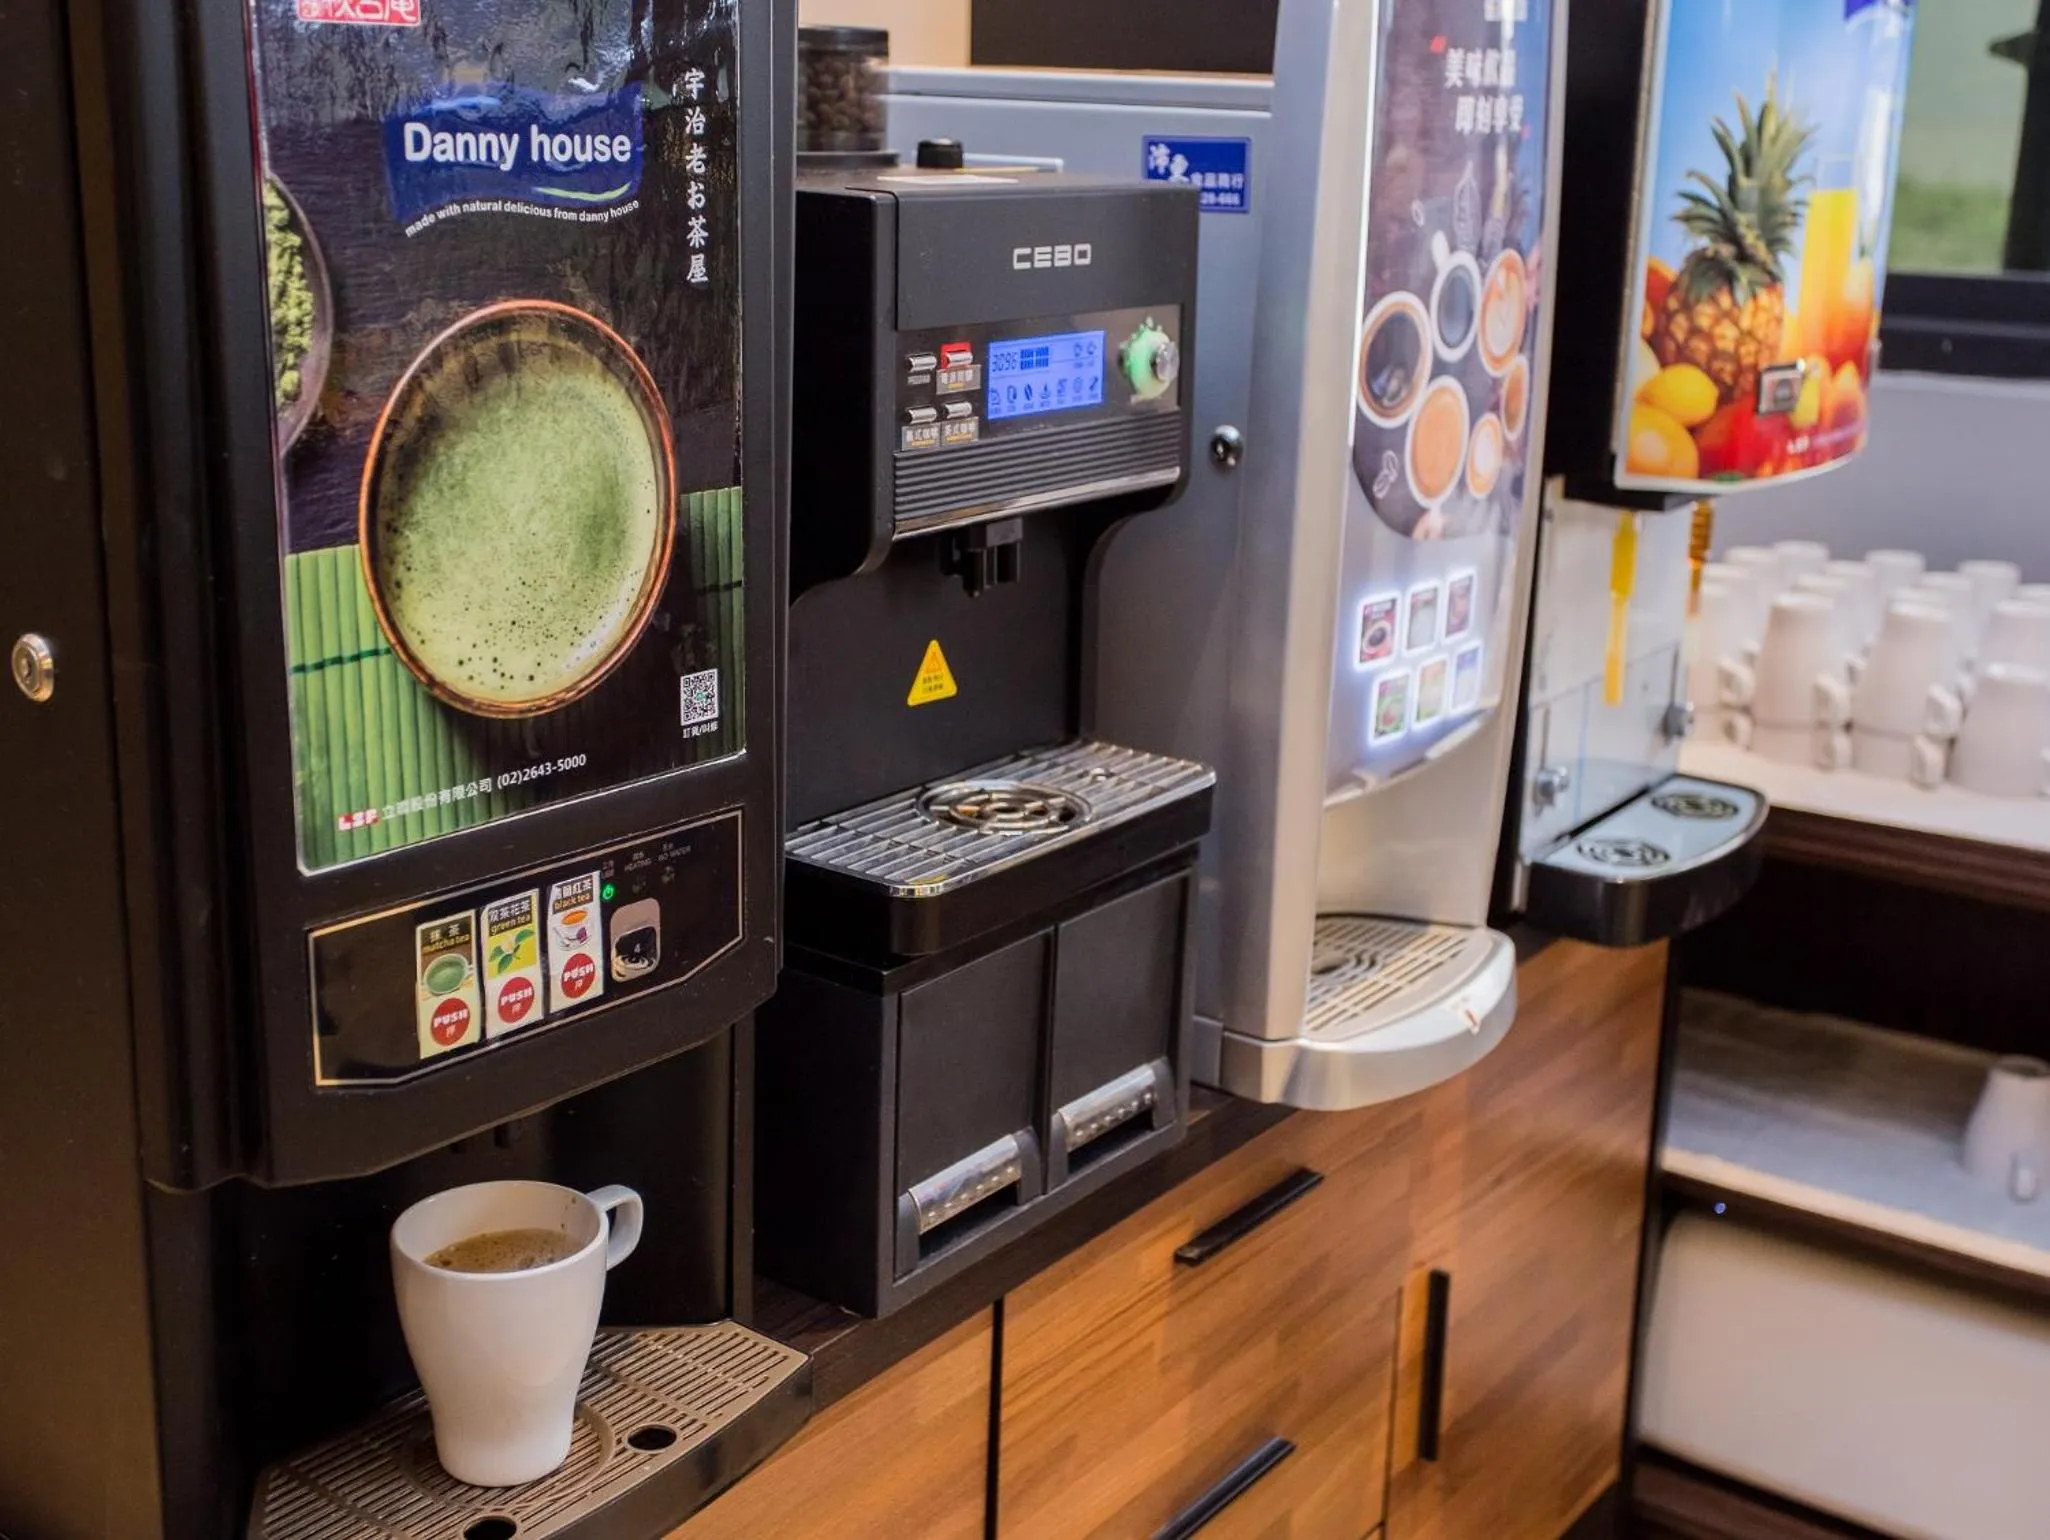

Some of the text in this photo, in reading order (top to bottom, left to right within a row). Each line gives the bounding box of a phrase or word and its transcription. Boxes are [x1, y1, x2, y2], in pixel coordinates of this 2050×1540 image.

[403, 121, 632, 172] Danny house
[405, 200, 639, 238] made with natural delicious from danny house
[1012, 243, 1092, 270] CEBO
[497, 753, 588, 790] (02)2643-5000
[554, 892, 591, 910] black tea
[491, 913, 531, 936] green tea
[455, 934, 470, 944] tea
[564, 963, 593, 981] PUSH
[500, 987, 532, 1006] PUSH
[434, 1008, 468, 1028] PUSH
